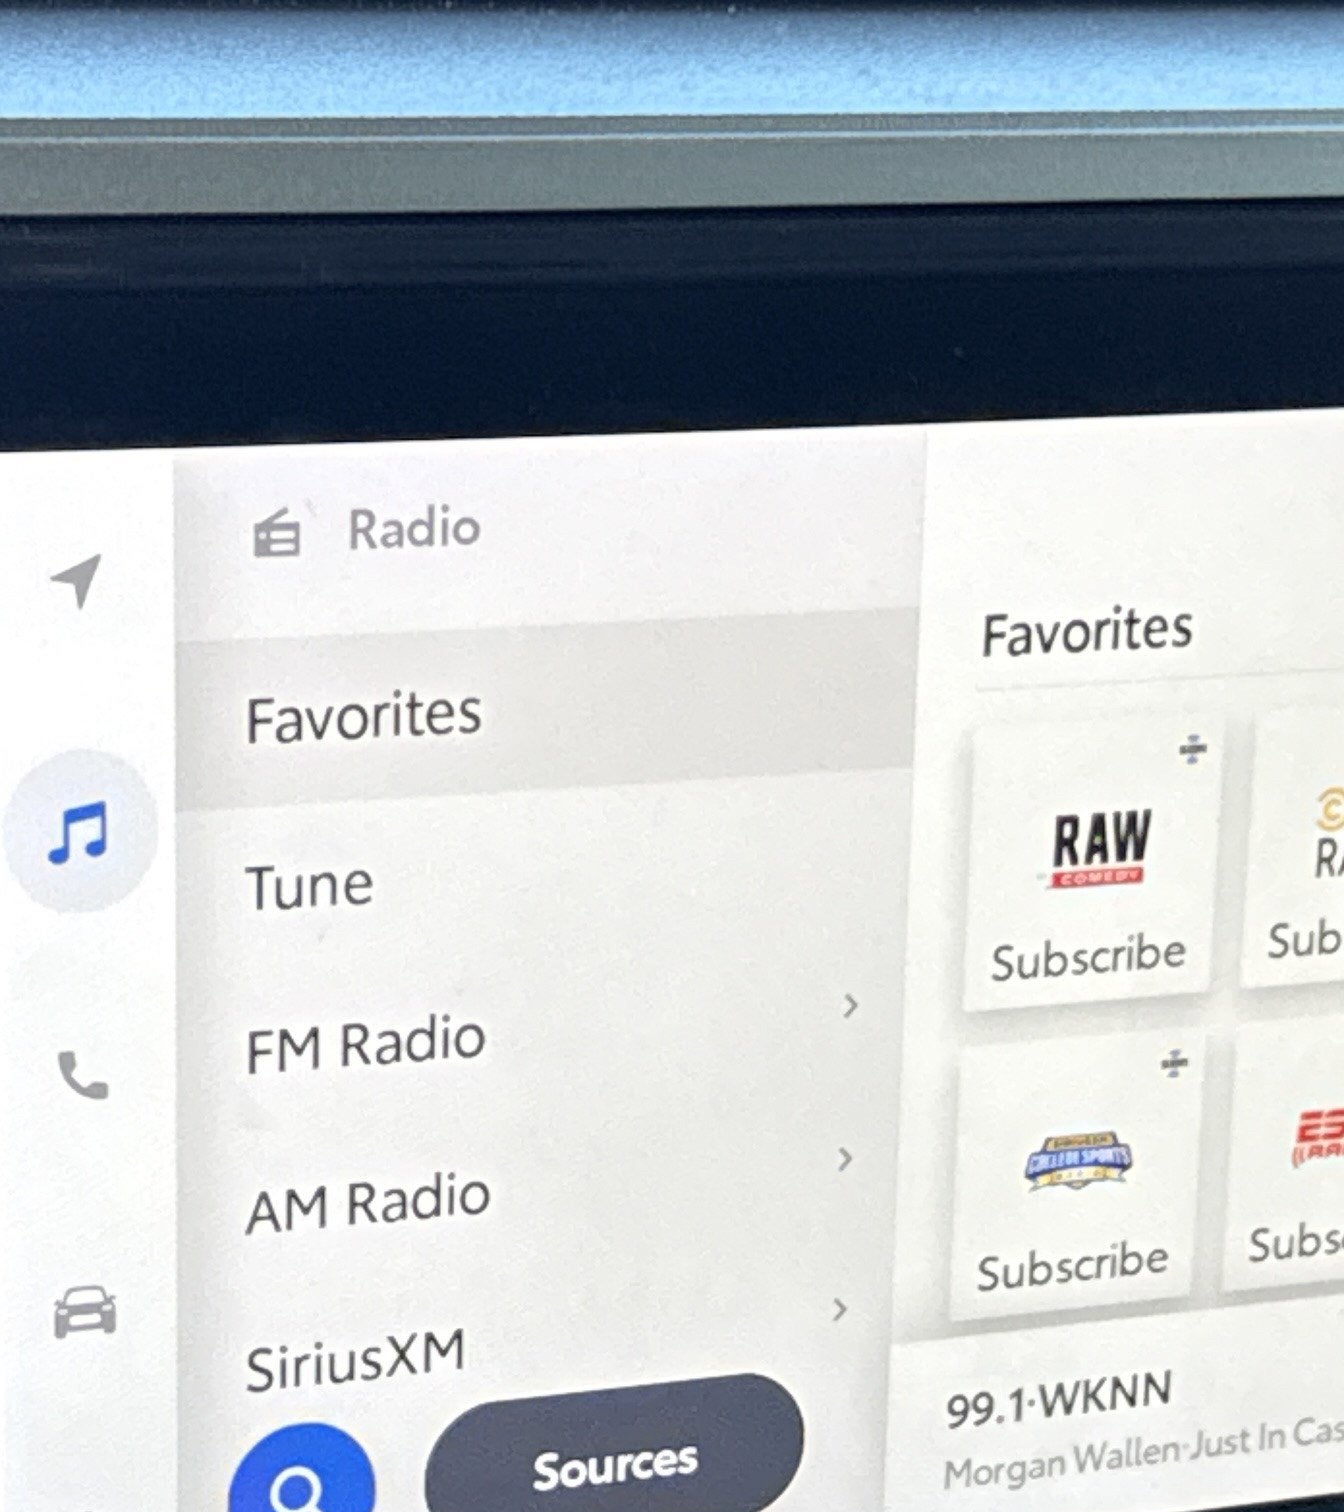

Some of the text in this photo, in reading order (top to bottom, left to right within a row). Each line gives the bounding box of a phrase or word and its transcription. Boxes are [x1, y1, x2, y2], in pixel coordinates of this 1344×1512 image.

[350, 504, 480, 550] Radio
[984, 605, 1192, 657] Favorites
[249, 690, 480, 743] Favorites
[1053, 809, 1152, 867] RAW
[245, 866, 372, 910] Tune
[992, 933, 1186, 981] Subscribe
[249, 1014, 485, 1074] FM Radio
[246, 1172, 490, 1234] AM Radio
[978, 1241, 1168, 1292] Subscribe
[247, 1329, 463, 1393] SiriusXM
[534, 1447, 698, 1491] Sources
[945, 1456, 1065, 1490] Morgan
[1259, 1423, 1285, 1450] In
